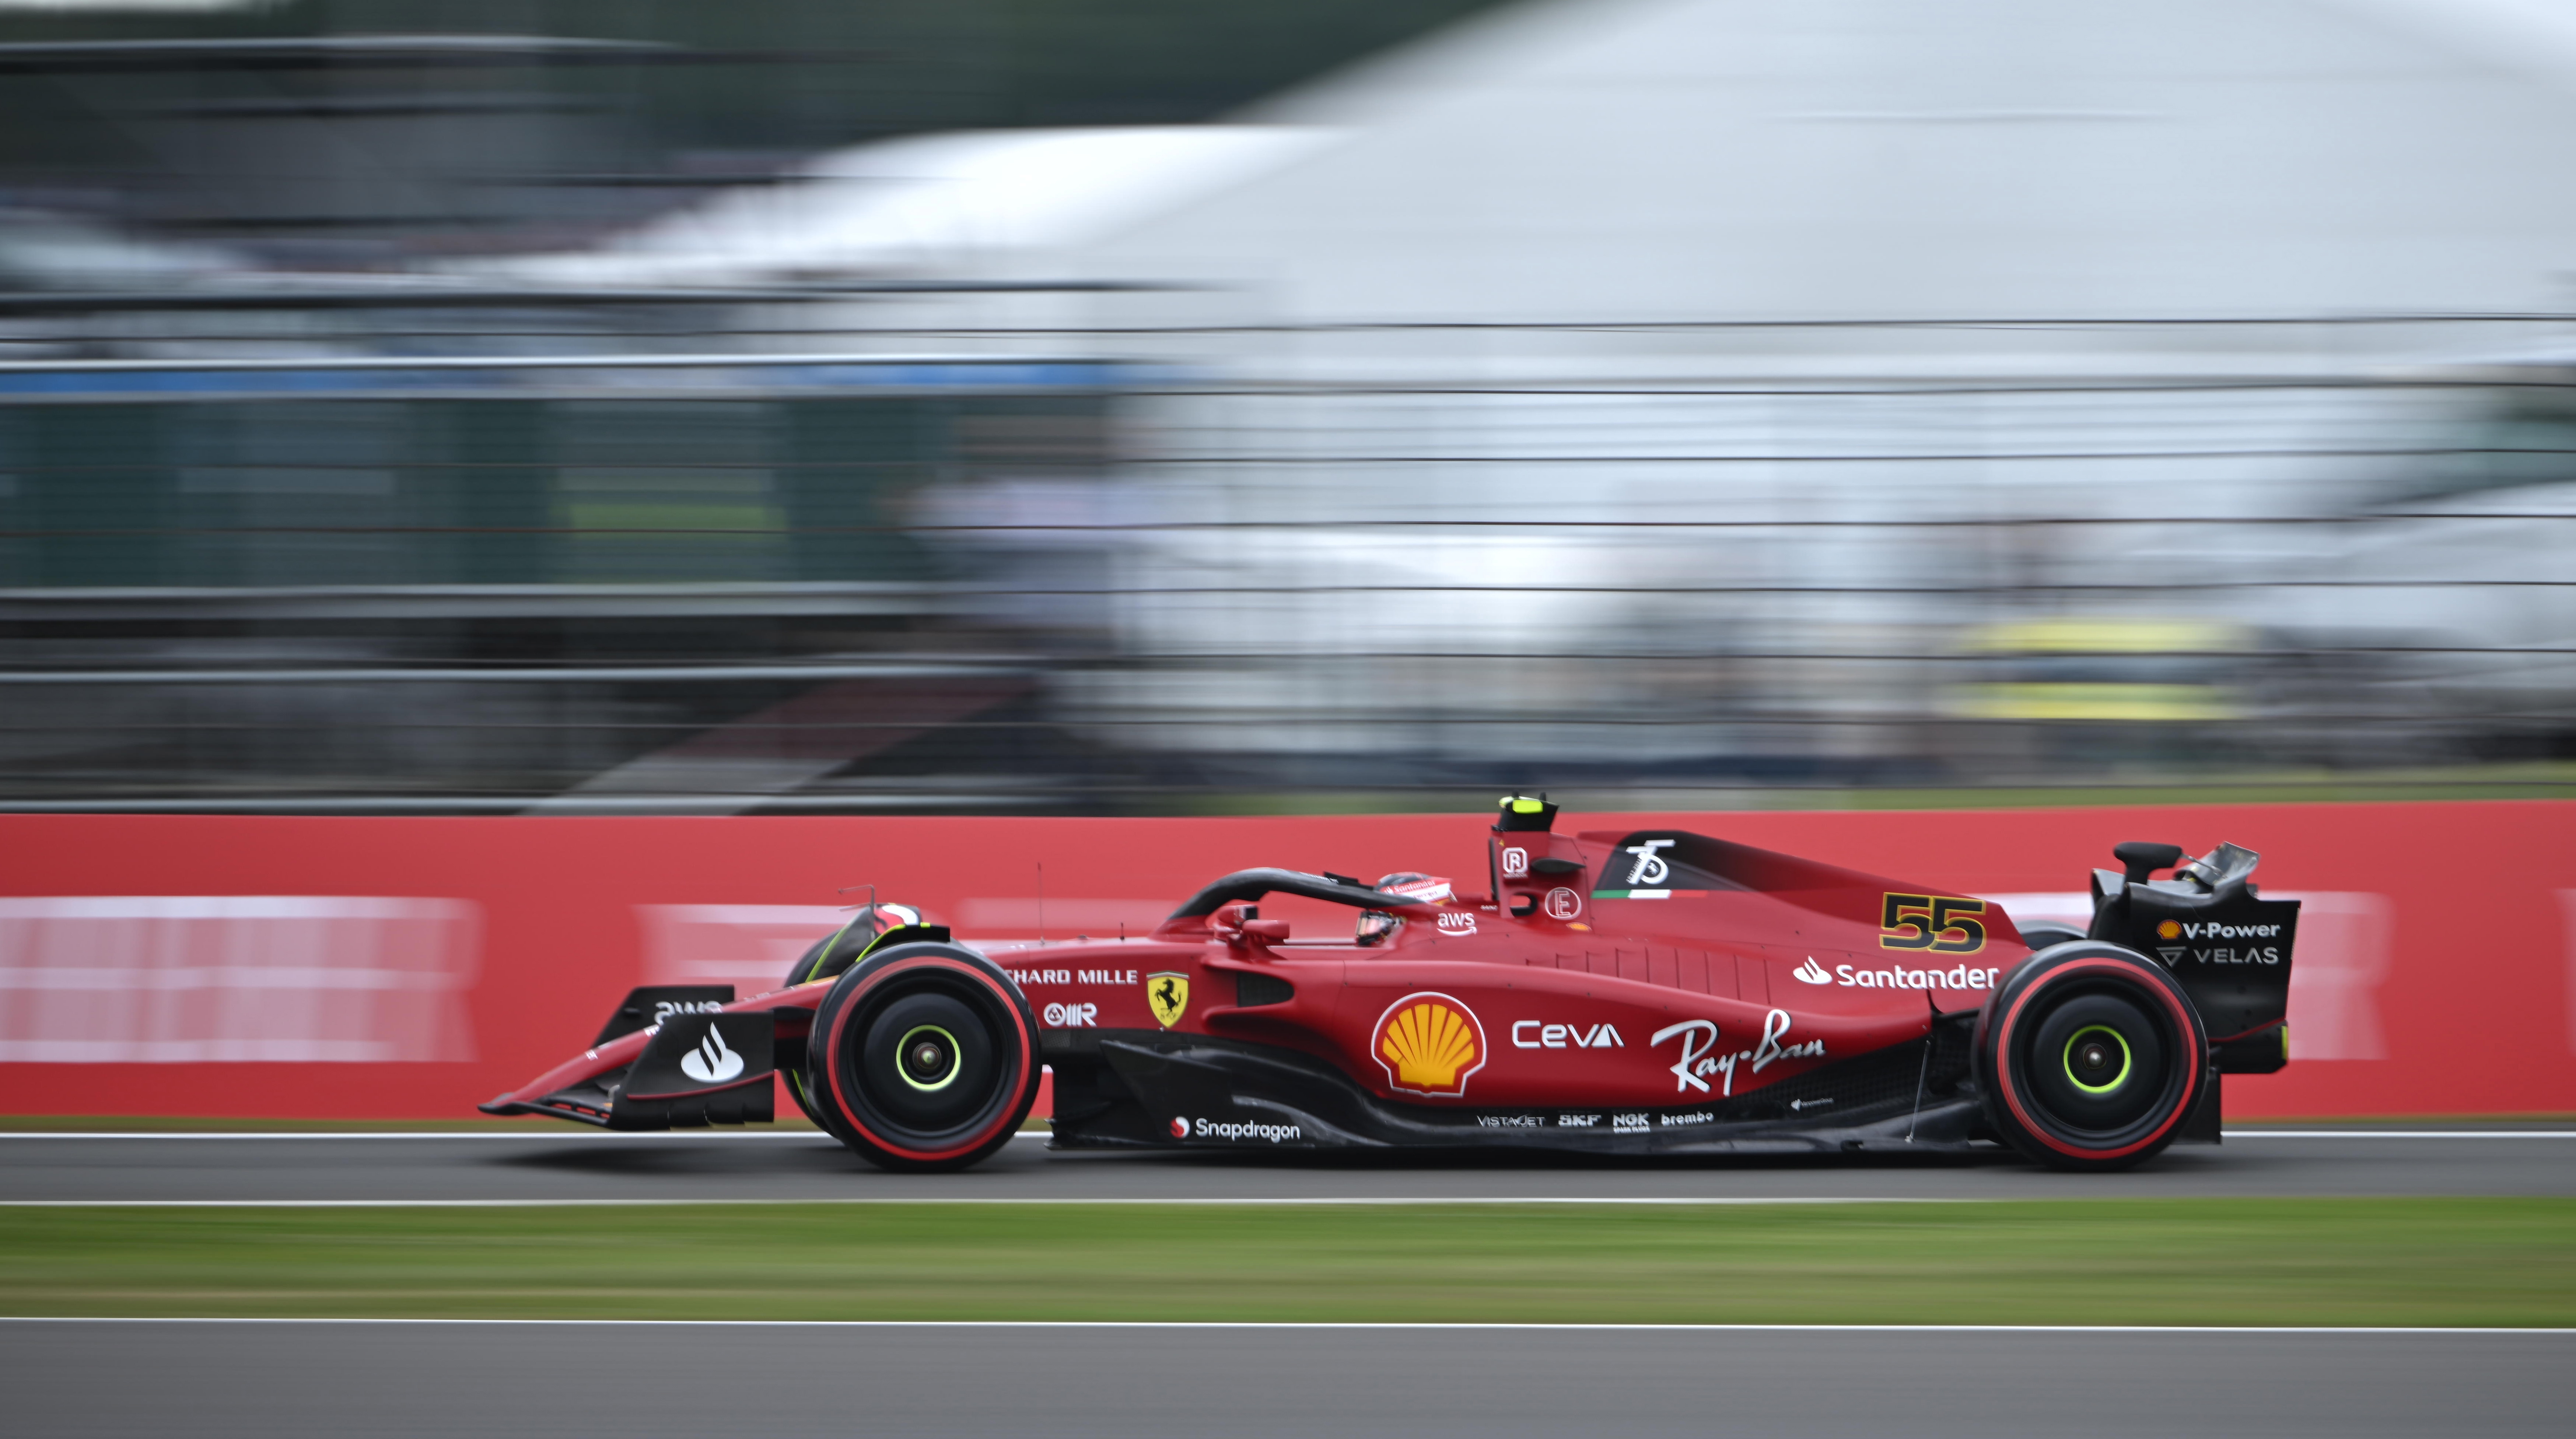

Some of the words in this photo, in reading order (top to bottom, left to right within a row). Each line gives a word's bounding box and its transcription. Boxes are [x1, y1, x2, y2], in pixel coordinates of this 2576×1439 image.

[1394, 880, 1435, 893] Santander
[1438, 913, 1476, 928] aws
[1879, 892, 1987, 955] 55
[2182, 922, 2281, 940] V-Power
[2193, 947, 2279, 965] VELAS
[1078, 969, 1138, 985] MILLE
[1836, 964, 2000, 990] Santander
[1558, 1115, 1602, 1127] SKF
[1613, 1113, 1650, 1126] NGK
[1661, 1111, 1714, 1127] brembo
[1196, 1118, 1300, 1144] Snapdragon
